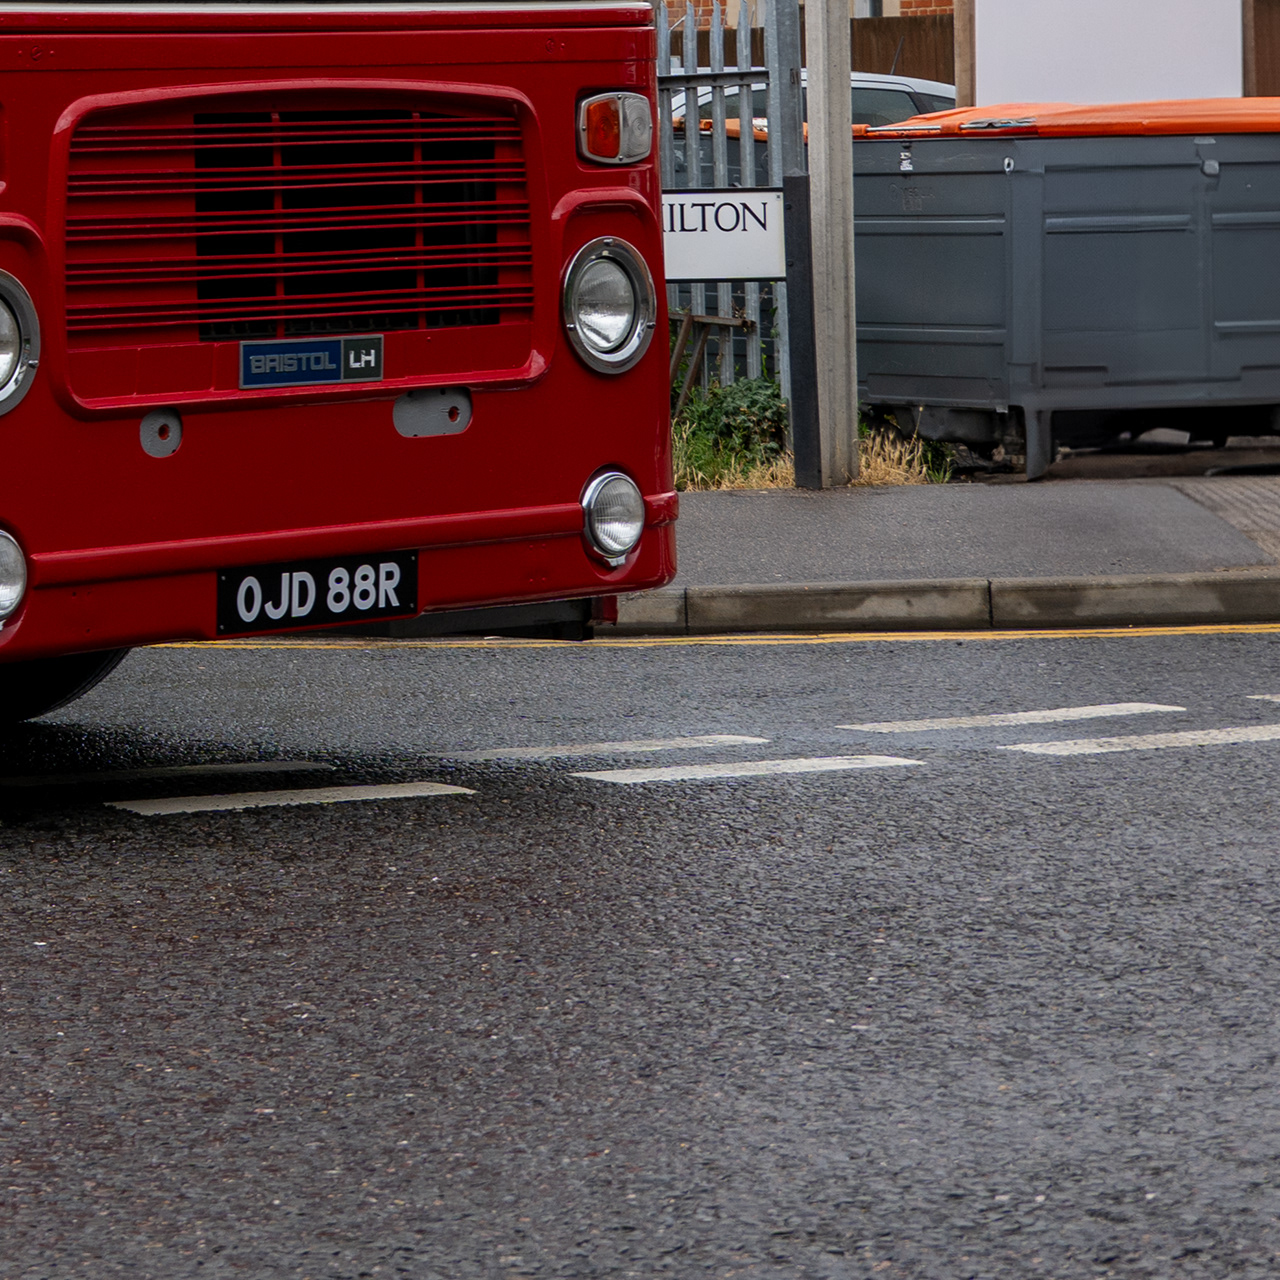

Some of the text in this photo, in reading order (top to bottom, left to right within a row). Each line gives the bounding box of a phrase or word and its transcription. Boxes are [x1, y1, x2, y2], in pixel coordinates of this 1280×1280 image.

[662, 201, 768, 233] ILTON
[249, 348, 376, 374] BRISTOL LH
[236, 561, 401, 623] OJD 88R
